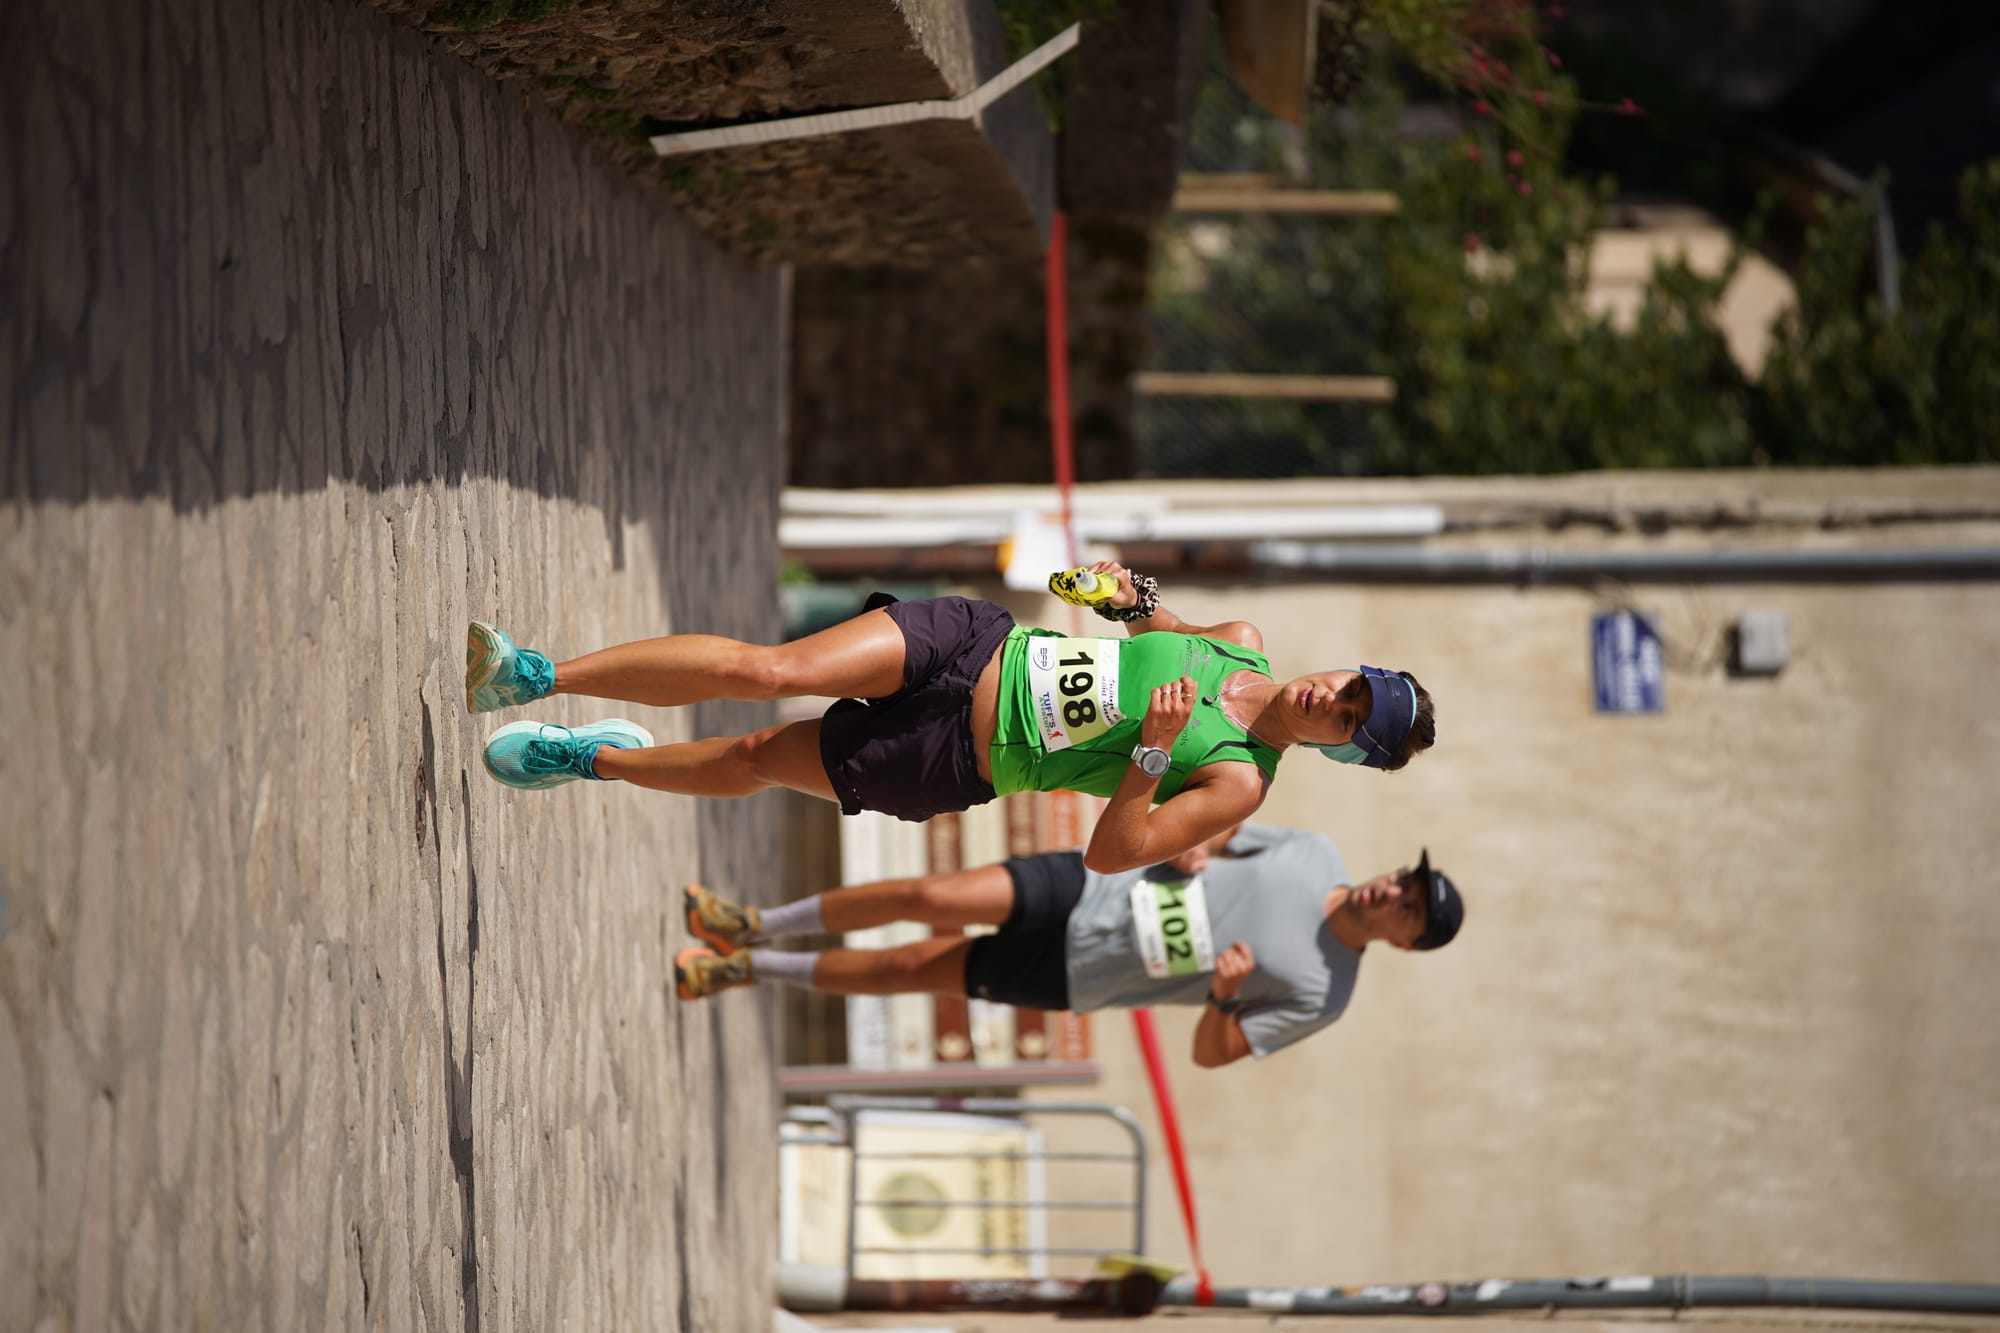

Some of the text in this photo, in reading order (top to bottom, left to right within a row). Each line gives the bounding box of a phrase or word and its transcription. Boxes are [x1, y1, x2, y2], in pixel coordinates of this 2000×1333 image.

[1043, 691, 1056, 729] TUFF'S
[1059, 651, 1097, 728] 198
[1160, 899, 1192, 962] 102
